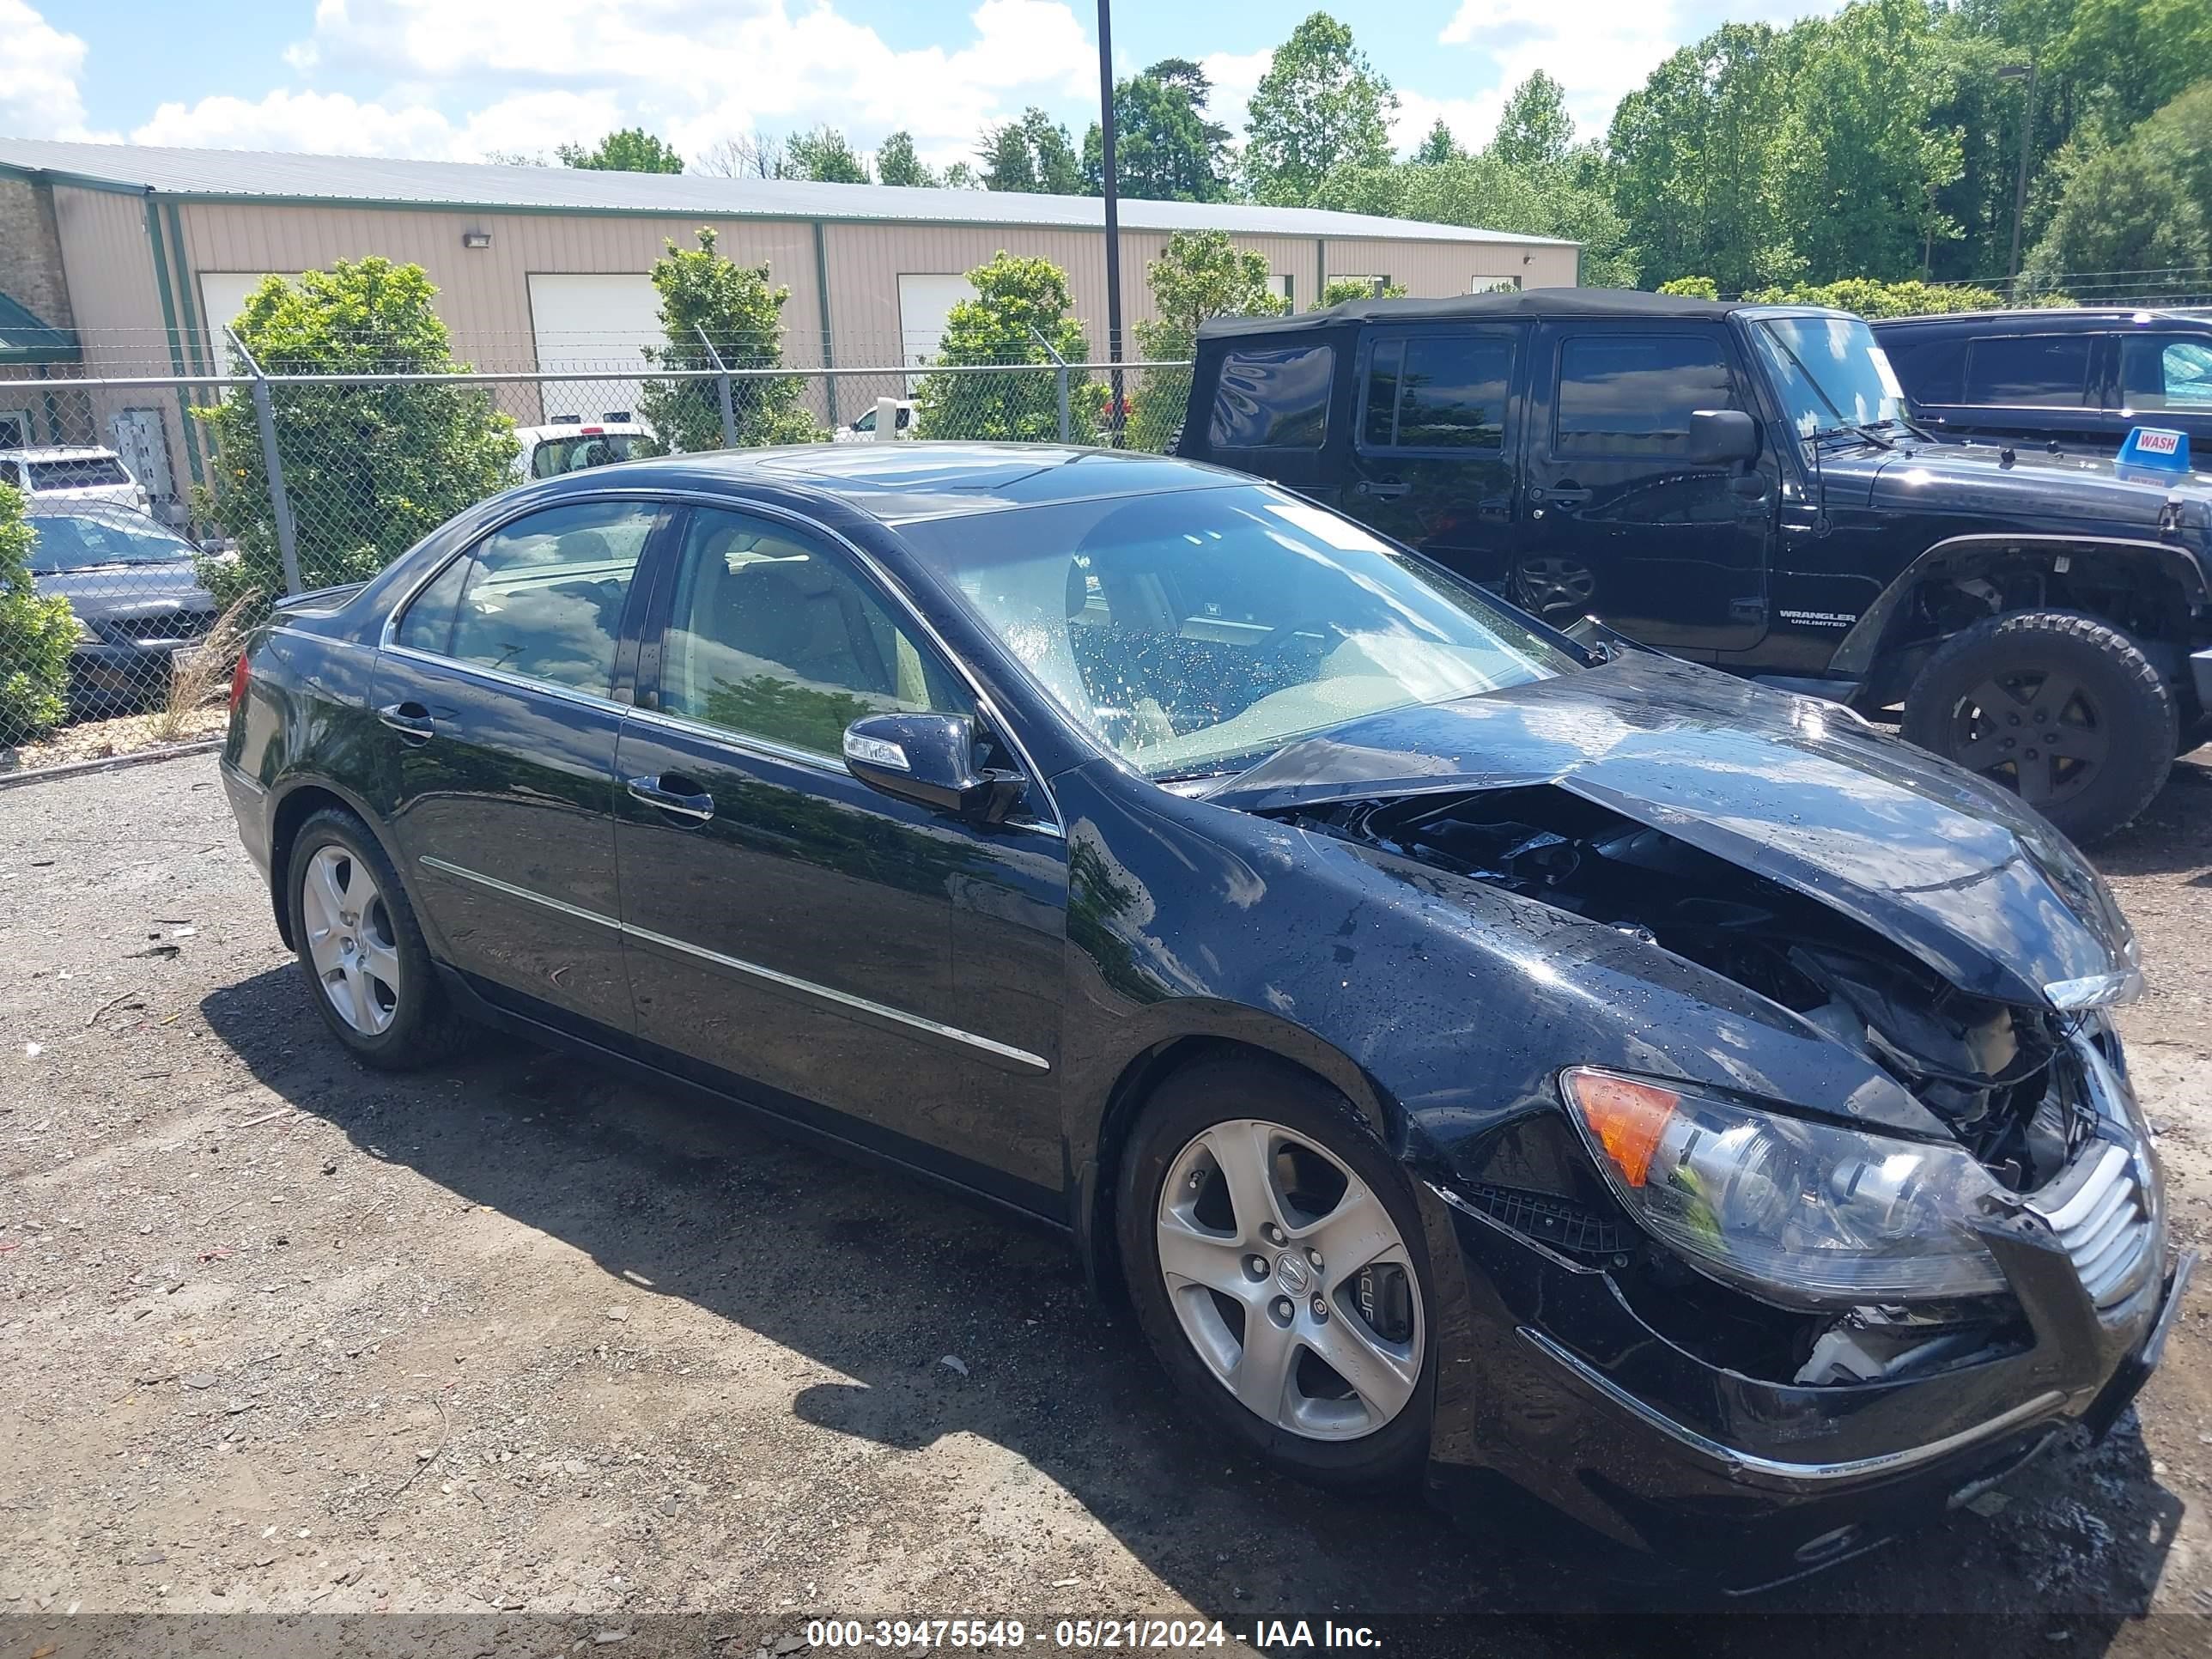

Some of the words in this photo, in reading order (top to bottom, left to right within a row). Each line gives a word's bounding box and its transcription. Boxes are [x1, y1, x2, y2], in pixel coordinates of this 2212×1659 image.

[2141, 434, 2176, 451] WASH
[1779, 611, 1856, 623] WRANGLER
[1791, 619, 1847, 628] UNLIMITED
